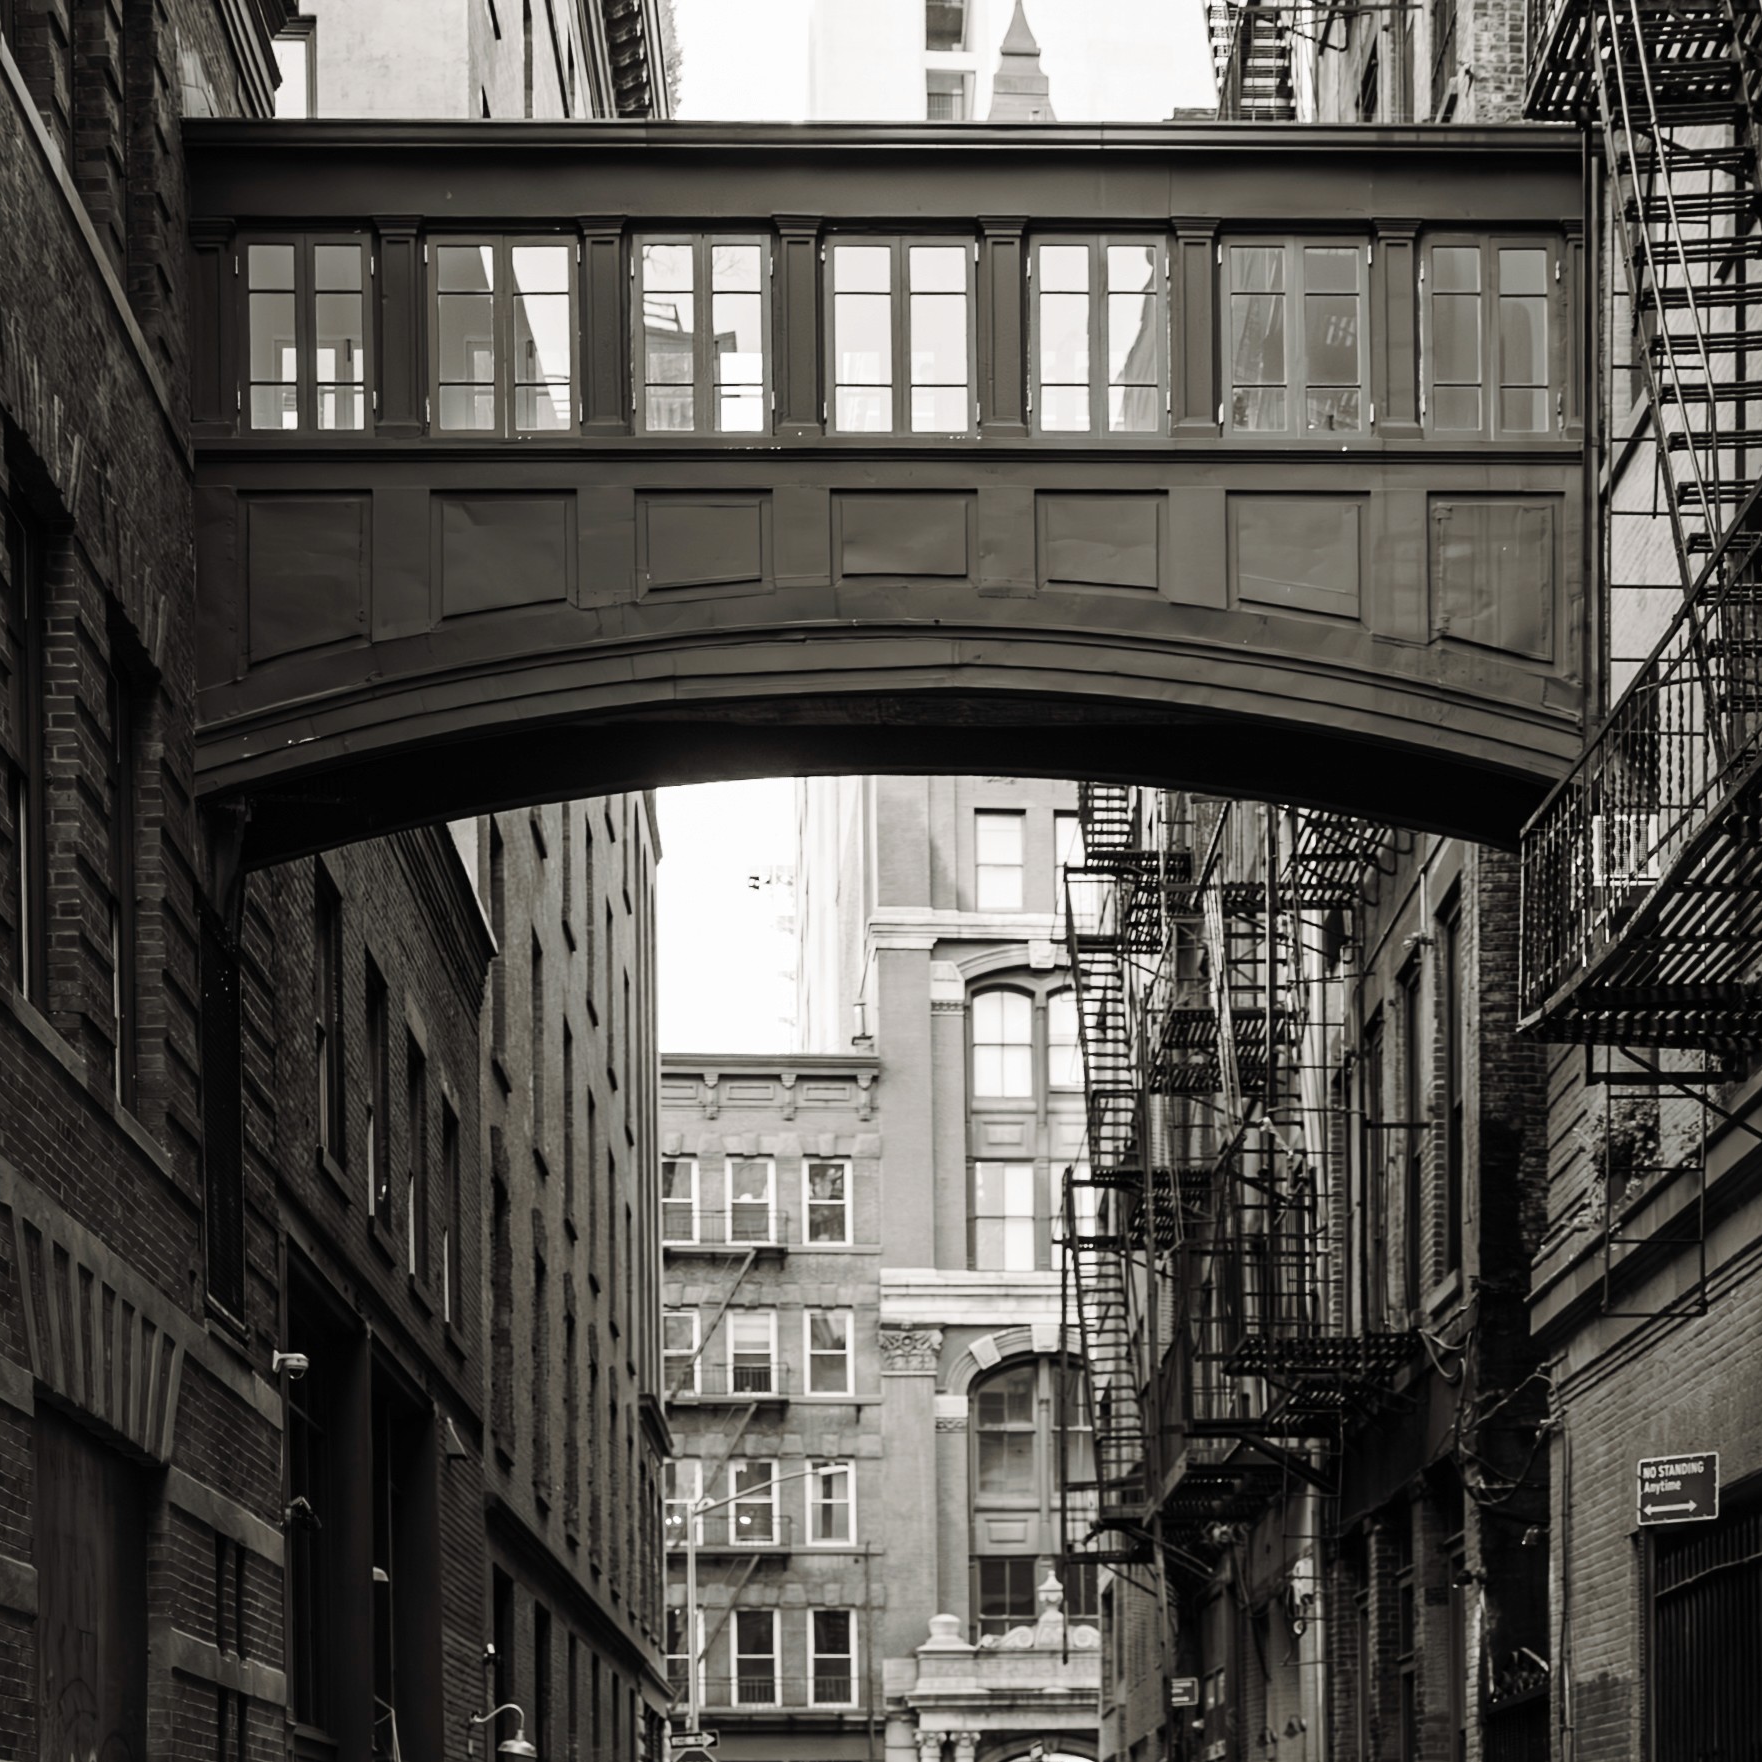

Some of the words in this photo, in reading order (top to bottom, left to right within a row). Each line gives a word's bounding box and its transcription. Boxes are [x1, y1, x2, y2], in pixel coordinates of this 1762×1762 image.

[1642, 1465, 1657, 1479] NO
[1658, 1461, 1704, 1477] STANDING
[1644, 1479, 1681, 1495] Anytime
